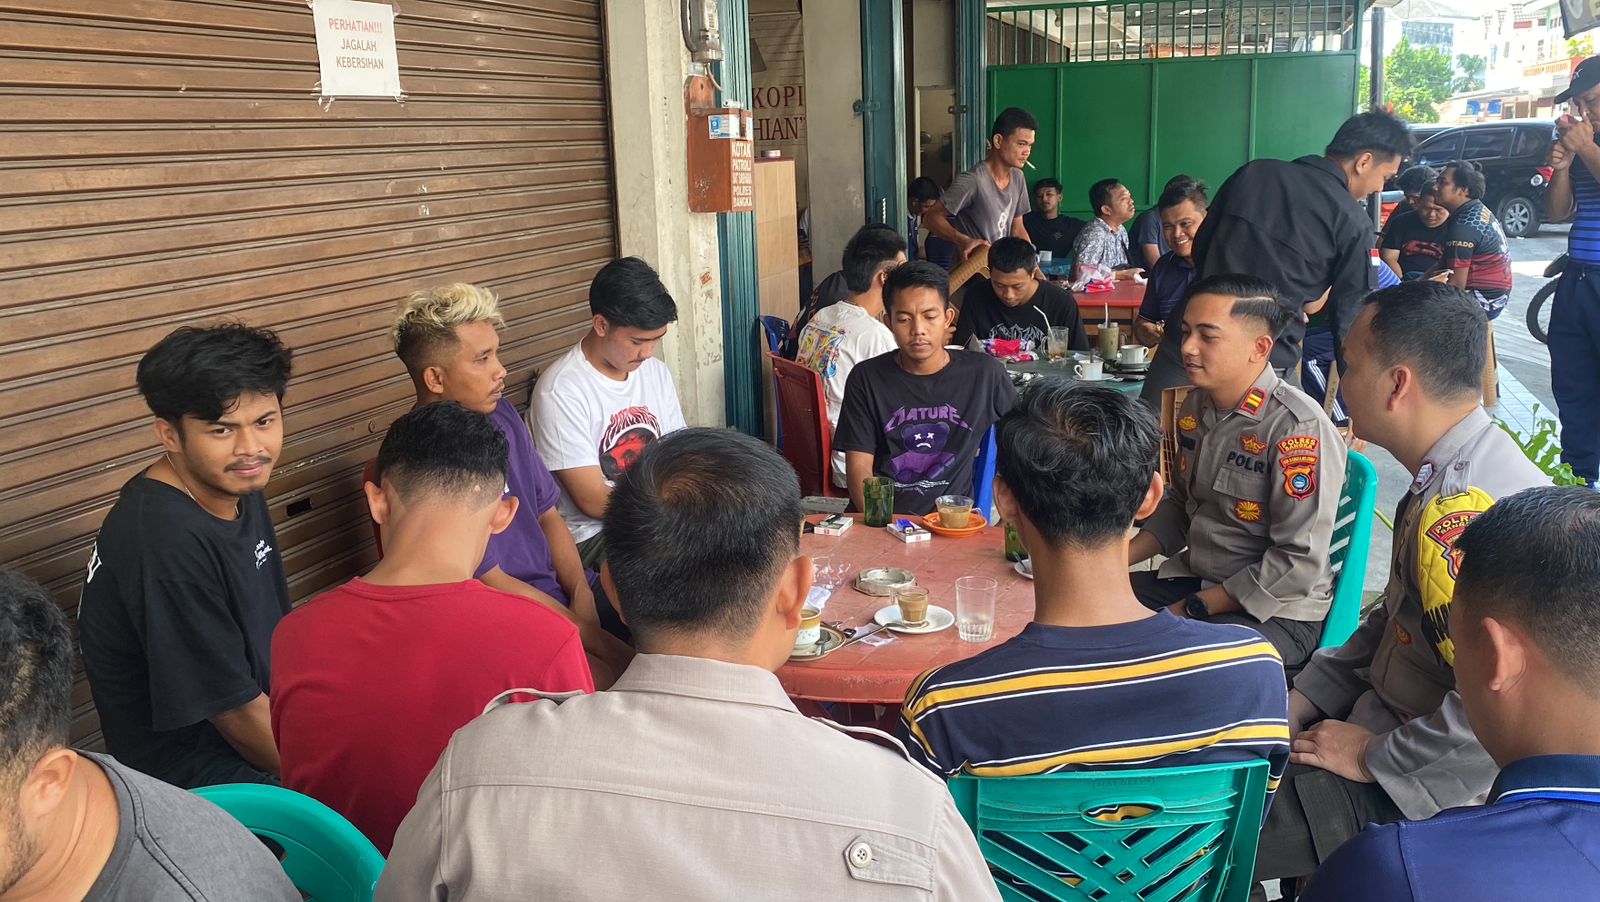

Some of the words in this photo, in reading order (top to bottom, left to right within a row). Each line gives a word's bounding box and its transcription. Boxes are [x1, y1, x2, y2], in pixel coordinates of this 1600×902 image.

[328, 17, 383, 34] PERHATIAN!!!
[340, 38, 377, 52] JAGALAH
[336, 56, 384, 70] KEBERSIHAN
[731, 141, 752, 158] KOTAK
[733, 185, 752, 196] POLRES
[1281, 437, 1316, 449] POLRES
